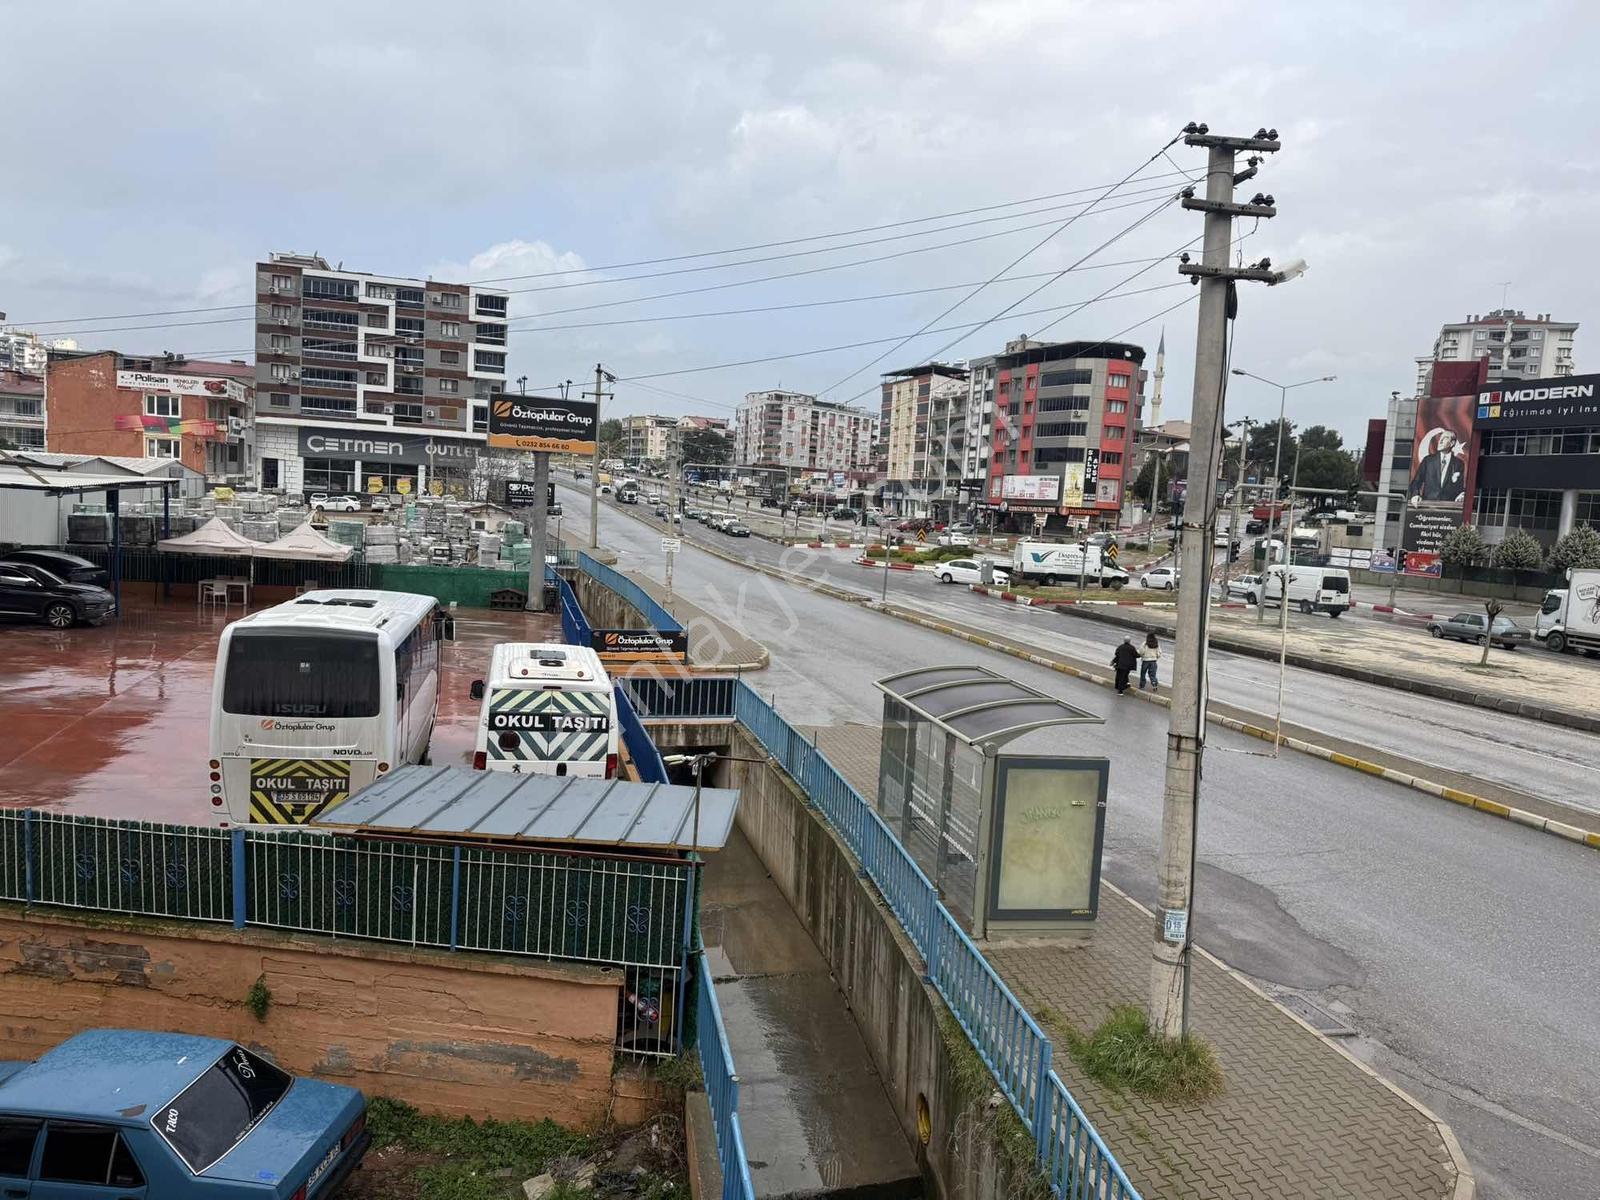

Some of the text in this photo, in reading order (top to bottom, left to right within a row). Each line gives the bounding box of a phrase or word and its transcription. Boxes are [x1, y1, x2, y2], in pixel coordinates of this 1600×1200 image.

[134, 373, 169, 384] Polisan
[1504, 384, 1594, 402] MODERN
[512, 405, 593, 426] Öztoplular Grup
[425, 443, 481, 458] OUTLET
[1085, 449, 1094, 479] SALON
[617, 635, 673, 646] Öztoplular Grup
[276, 703, 327, 714] ISUZU
[274, 721, 335, 731] Öztoplular Grup
[494, 714, 607, 731] OKUL TAŞITI
[256, 777, 346, 792] OKUL TAŞITI
[165, 1108, 179, 1134] TACO
